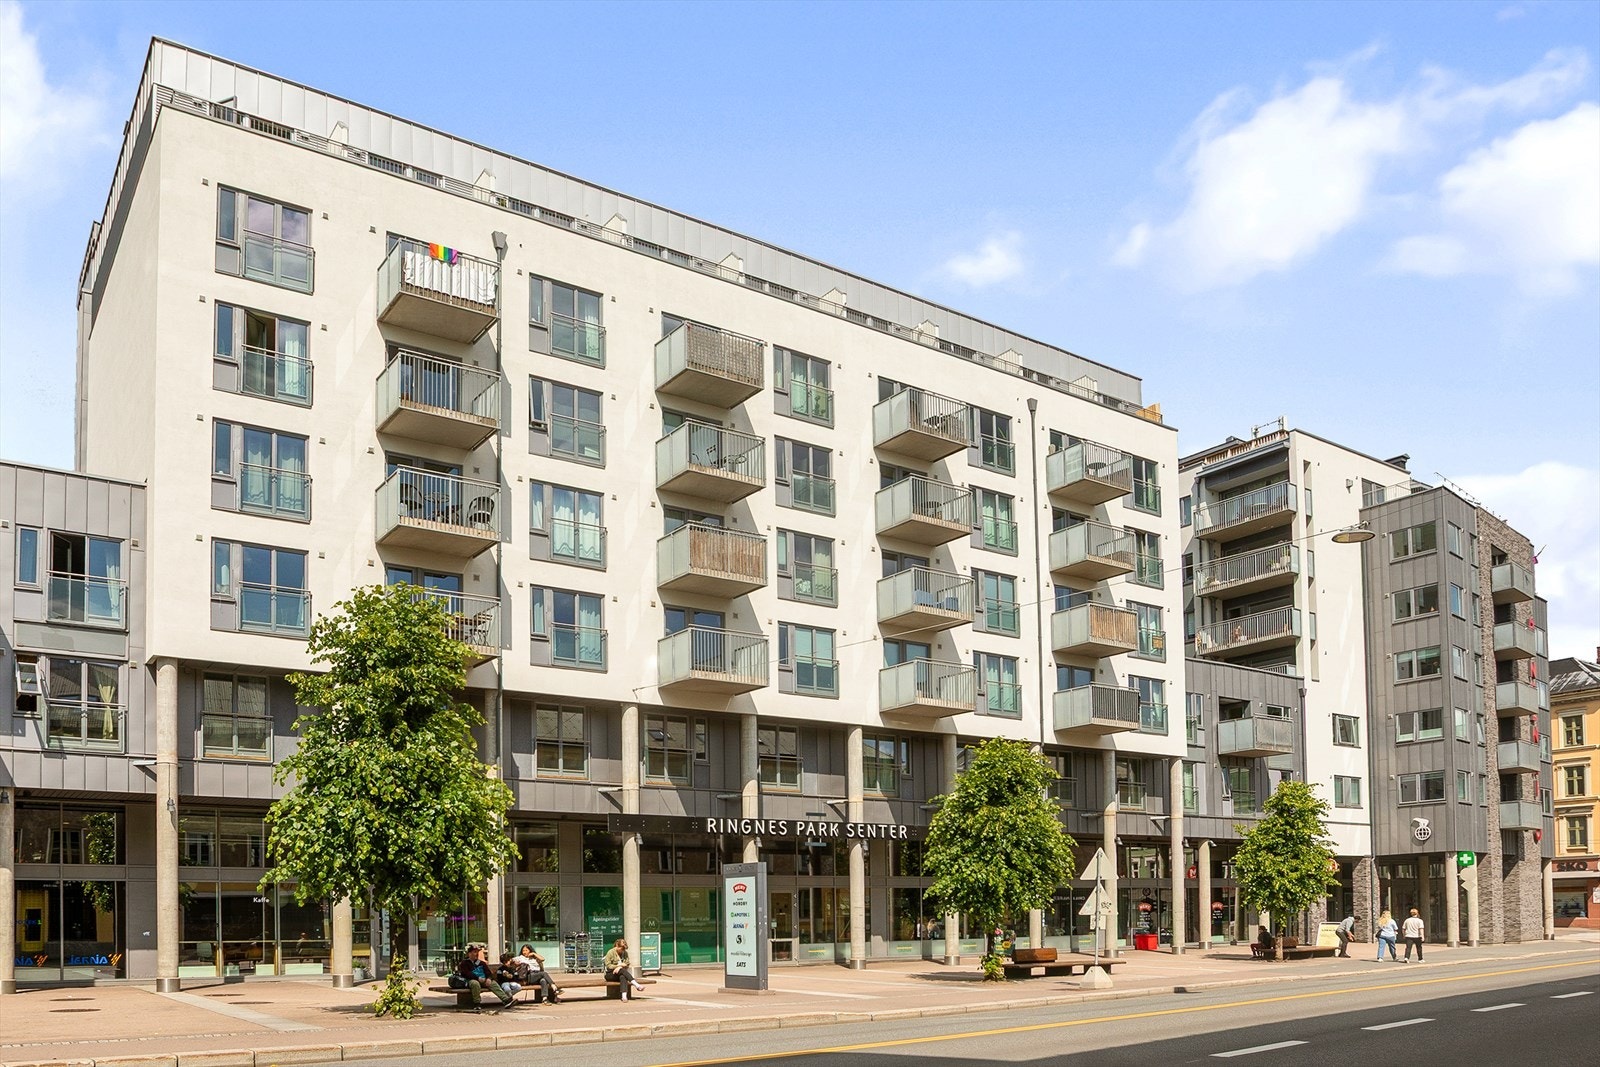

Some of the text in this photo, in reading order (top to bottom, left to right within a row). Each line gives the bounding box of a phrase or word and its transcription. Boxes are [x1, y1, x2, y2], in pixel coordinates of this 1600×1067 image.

[707, 817, 908, 839] RINGNES PARK SENTER
